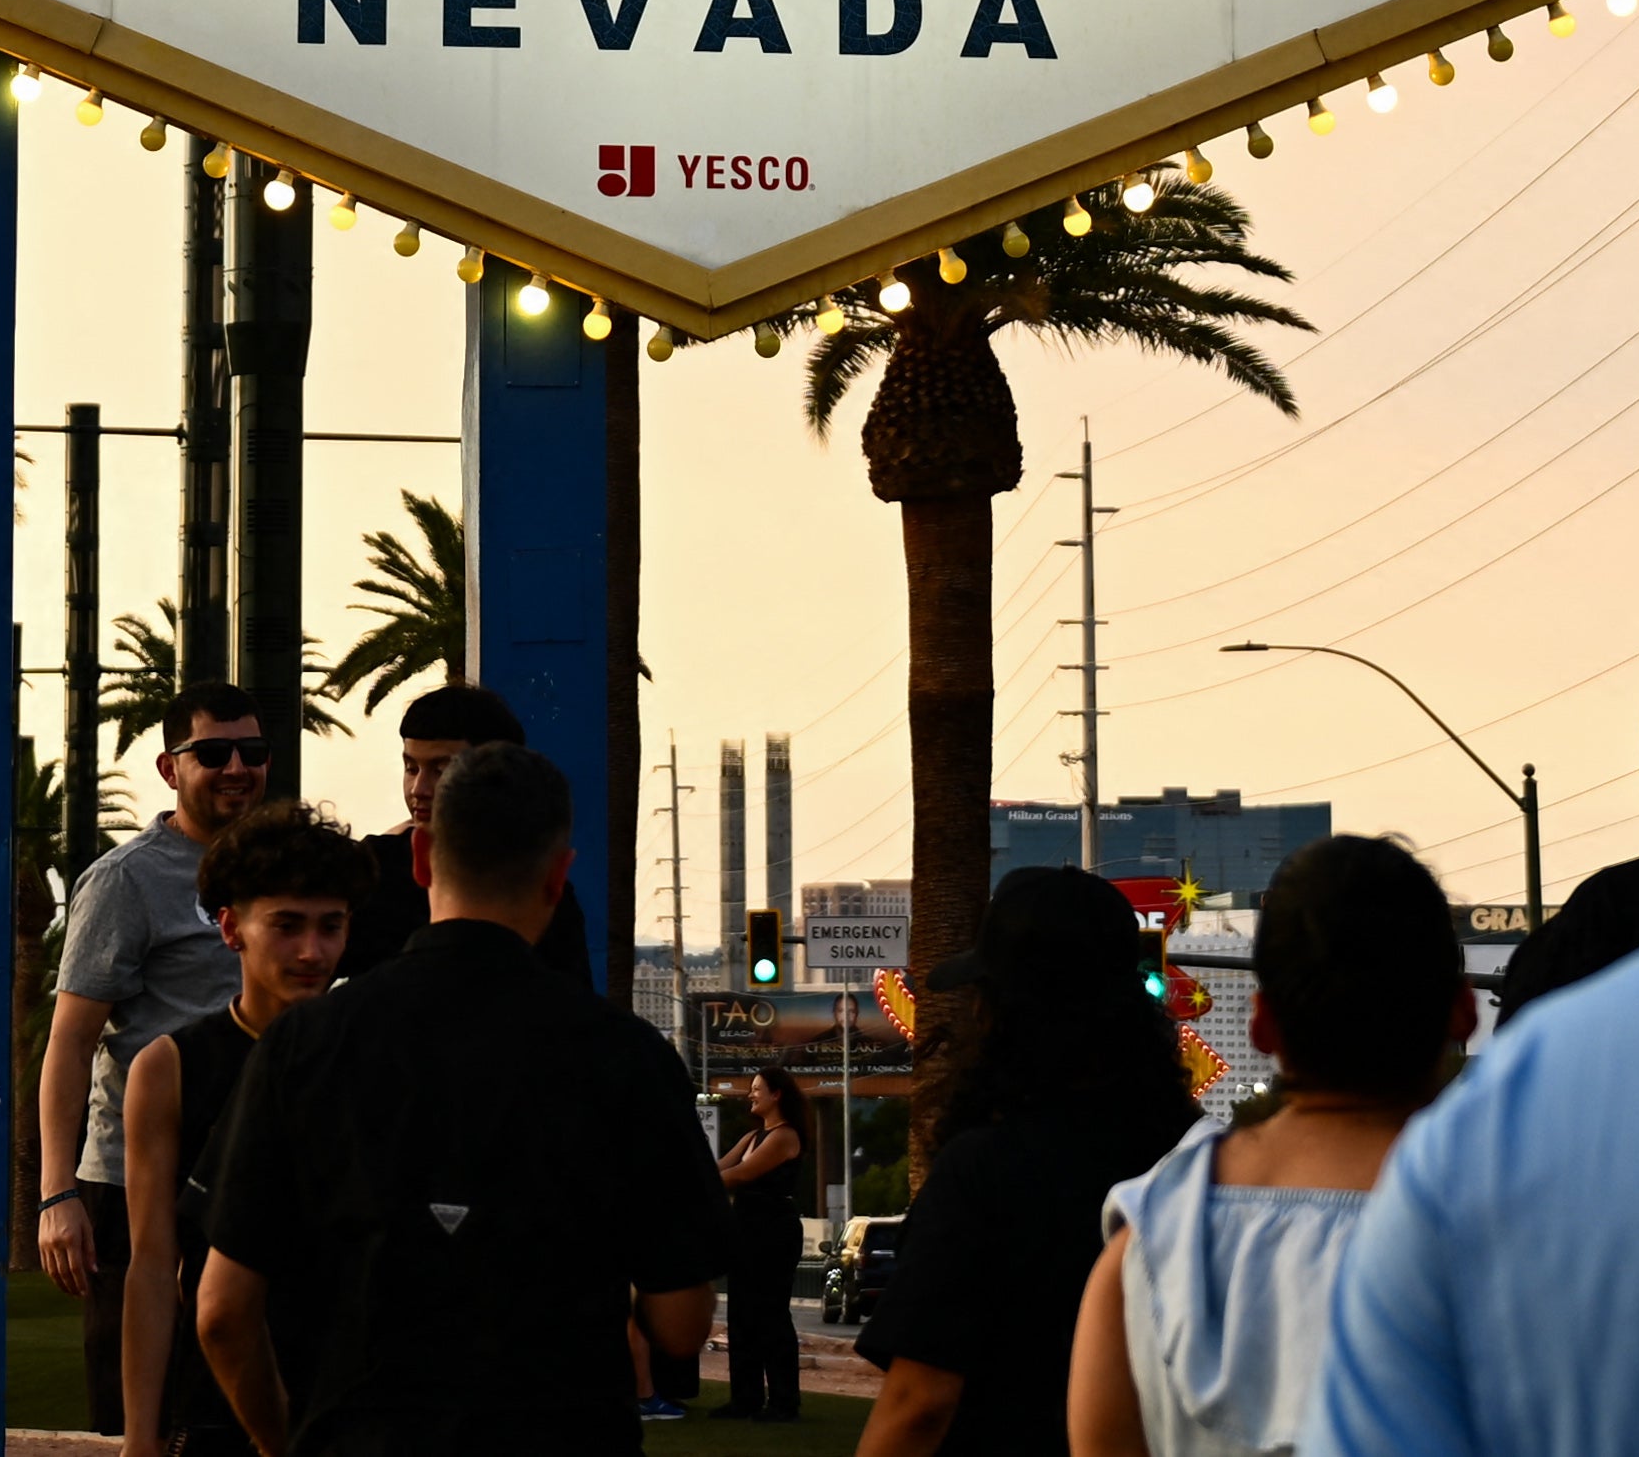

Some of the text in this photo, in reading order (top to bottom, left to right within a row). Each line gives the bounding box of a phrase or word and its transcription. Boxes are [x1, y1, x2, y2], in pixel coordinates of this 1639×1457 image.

[1008, 810, 1043, 821] Hilton
[1045, 810, 1078, 821] Grand
[811, 926, 902, 939] EMERGENCY
[830, 945, 886, 959] SIGNAL
[705, 1001, 775, 1028] TAO
